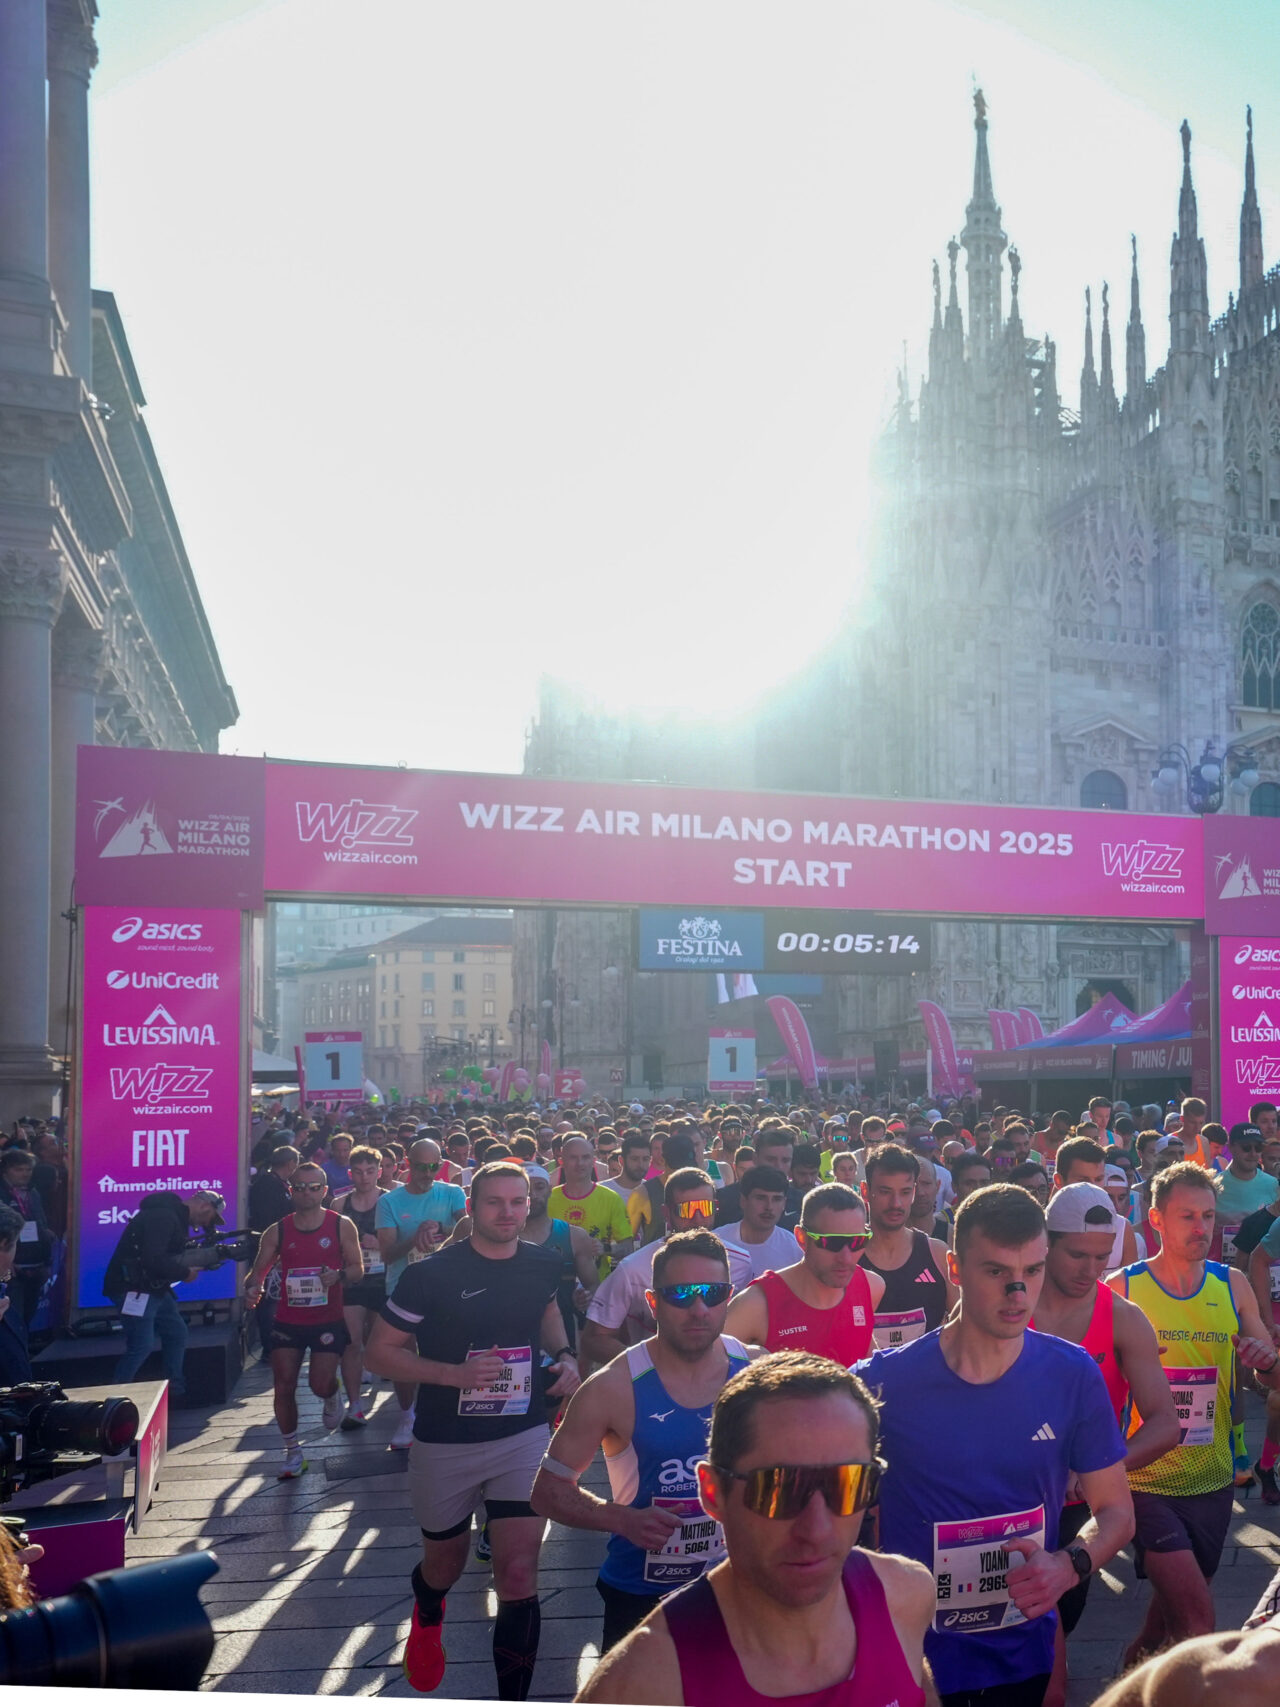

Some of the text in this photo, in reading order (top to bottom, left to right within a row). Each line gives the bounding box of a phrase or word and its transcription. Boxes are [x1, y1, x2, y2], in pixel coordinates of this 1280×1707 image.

[178, 819, 250, 833] WIZZ AIR
[296, 799, 419, 848] WIZZ
[459, 801, 1073, 856] WIZZ AIR MILANO MARATHON 2025
[178, 831, 250, 846] MILANO
[177, 845, 250, 857] MARATHON
[324, 850, 418, 865] wizzair.com
[1101, 840, 1184, 881] WIZZ
[733, 857, 852, 888] START
[1120, 882, 1185, 894] wizzair.com
[142, 922, 204, 941] asics
[656, 938, 743, 957] FESTINA
[777, 931, 920, 954] 00:05:14
[131, 971, 220, 990] UniCredit
[103, 1023, 217, 1047] LEVISSIMA
[325, 1051, 341, 1081] 1
[724, 1046, 738, 1072] 1
[1131, 1048, 1166, 1070] TIMING
[110, 1062, 214, 1104] WIZZ
[561, 1078, 573, 1094] 2
[132, 1103, 213, 1116] wizzair.com
[132, 1129, 190, 1168] FIAT
[889, 1331, 903, 1343] LUCA
[1158, 1329, 1229, 1344] TRIESTE ATLETICA
[1172, 1390, 1194, 1406] HOMAS
[661, 1482, 697, 1494] ROBER
[680, 1520, 716, 1541] MATTHIEU
[684, 1540, 709, 1555] 5064
[665, 1566, 692, 1576] asics
[980, 1549, 1010, 1574] YOANN
[959, 1610, 990, 1623] asics
